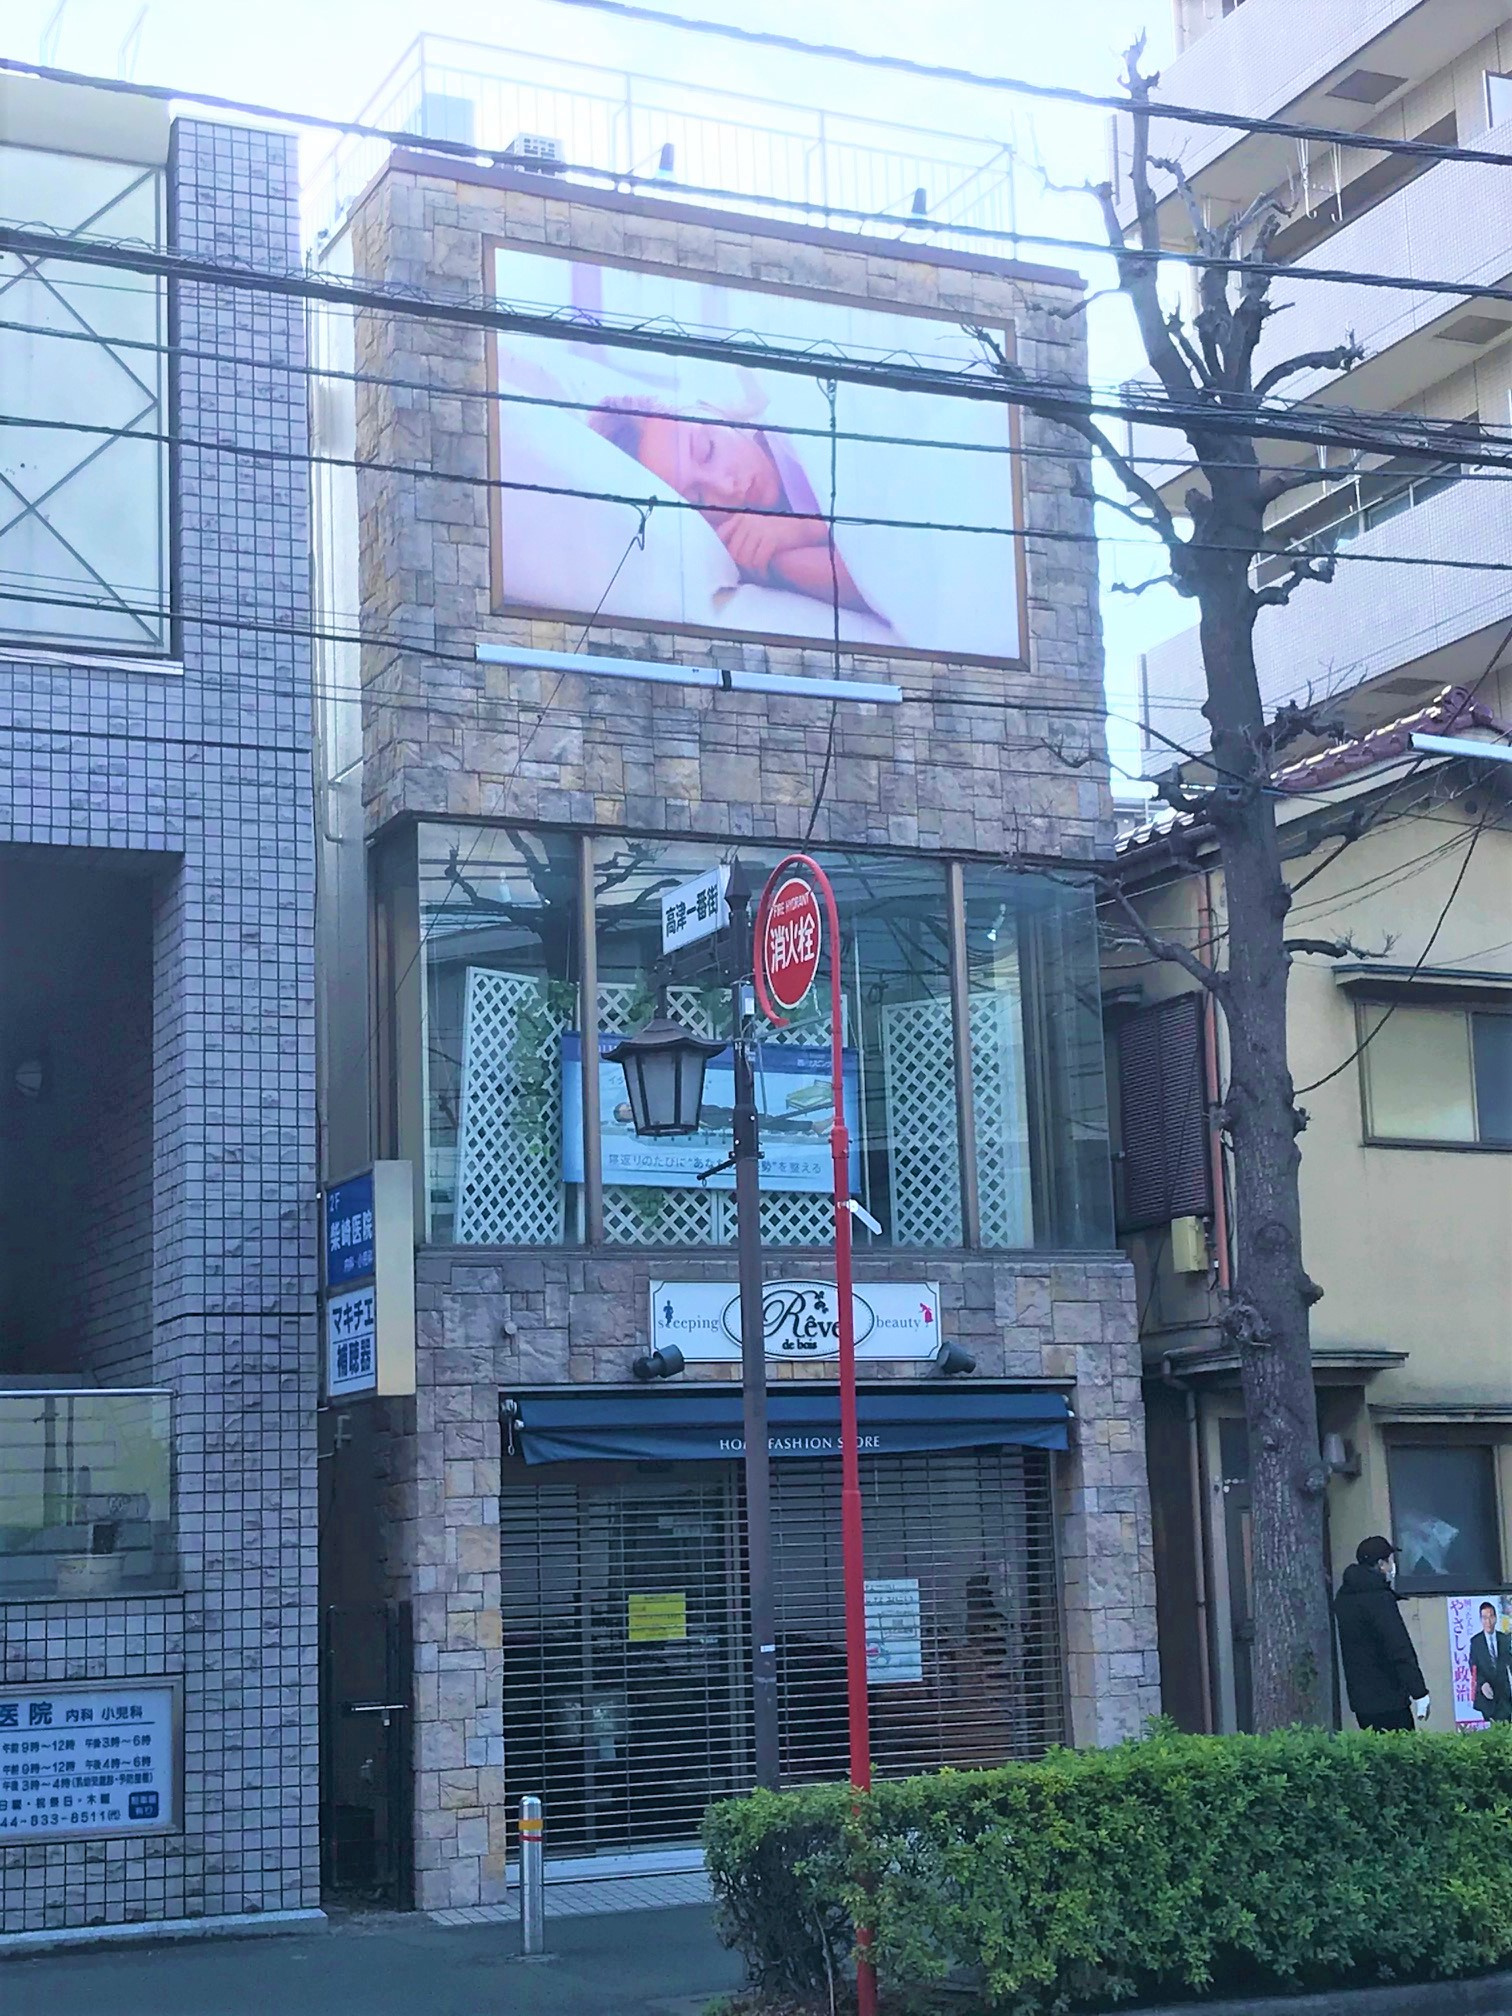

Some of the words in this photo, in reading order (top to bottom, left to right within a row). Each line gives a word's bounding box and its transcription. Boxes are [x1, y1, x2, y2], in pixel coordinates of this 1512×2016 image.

[666, 884, 718, 937] 高津一番街
[770, 912, 815, 974] 消火栓
[329, 1192, 341, 1212] 2F
[332, 1297, 374, 1335] マキチエ
[876, 1314, 922, 1333] beauty
[337, 1338, 372, 1378] 補聴器
[782, 1339, 796, 1351] de
[720, 1439, 747, 1451] HO
[768, 1437, 832, 1450] FASHION
[837, 1436, 880, 1449] SORE
[1450, 1599, 1470, 1702] やさしい政治
[0, 1701, 53, 1727] 医院
[66, 1708, 94, 1722] 内科
[101, 1705, 143, 1721] 小児科
